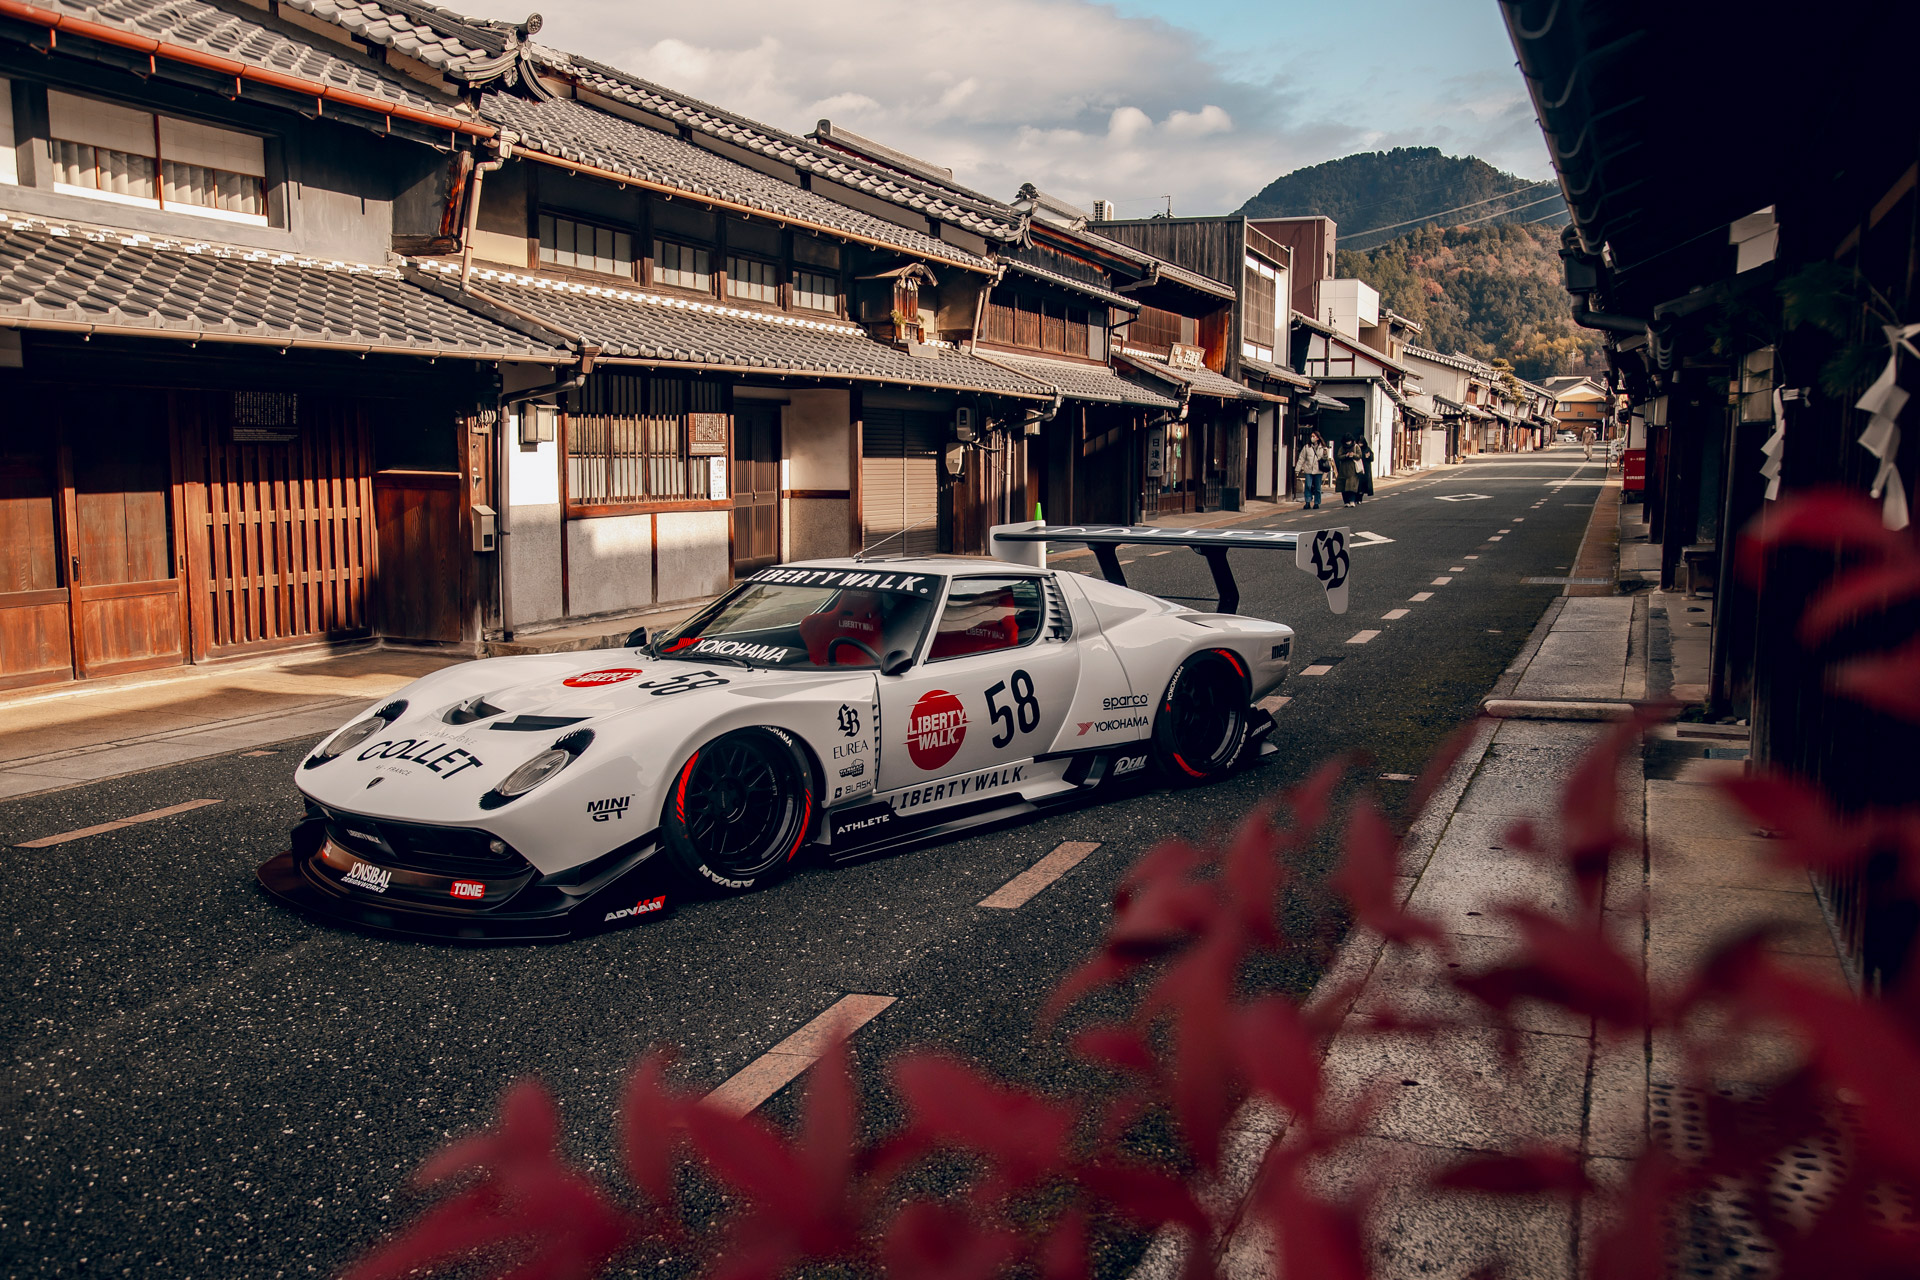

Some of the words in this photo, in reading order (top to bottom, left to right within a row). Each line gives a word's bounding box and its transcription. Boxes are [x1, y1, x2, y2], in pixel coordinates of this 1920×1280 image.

[745, 569, 845, 585] LIBERTY
[692, 639, 789, 663] YOKOHAMA
[638, 670, 731, 695] 58
[1166, 665, 1185, 701] YOKOHAMA
[984, 669, 1041, 749] 58
[1103, 694, 1148, 710] sparco
[908, 708, 967, 736] LIBERTY
[1094, 715, 1149, 732] YOKOHAMA
[357, 738, 484, 780] COLLET
[833, 739, 869, 759] EUREA
[586, 796, 630, 813] MINI
[889, 777, 971, 811] LIBERTY
[592, 807, 628, 822] GT
[837, 813, 890, 835] ATHLETE
[346, 861, 392, 888] JONSIBAL
[699, 864, 755, 888] ADVAN
[454, 882, 484, 897] TONE
[604, 900, 662, 921] ADVAN
